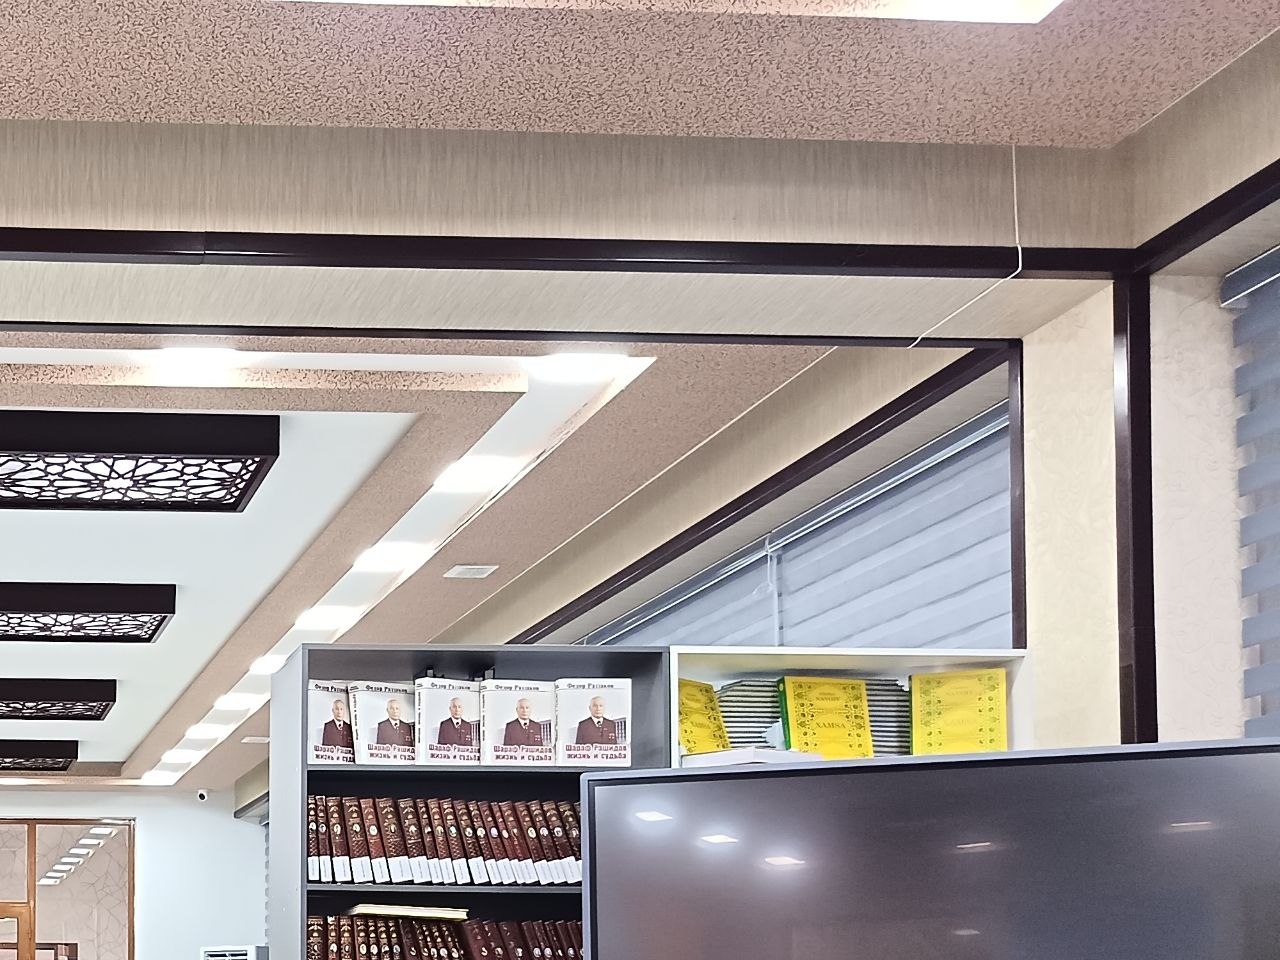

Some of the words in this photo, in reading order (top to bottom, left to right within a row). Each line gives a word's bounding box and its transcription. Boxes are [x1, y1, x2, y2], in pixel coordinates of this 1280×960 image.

[314, 745, 335, 753] Шараф
[368, 744, 390, 752] Шараф
[429, 744, 451, 752] Шараф
[521, 746, 552, 754] Рашидов
[566, 744, 591, 752] Шараф
[594, 744, 627, 752] Рашидов
[370, 752, 391, 760] жизнь
[430, 752, 451, 760] жизнь
[601, 753, 627, 761] судьба
